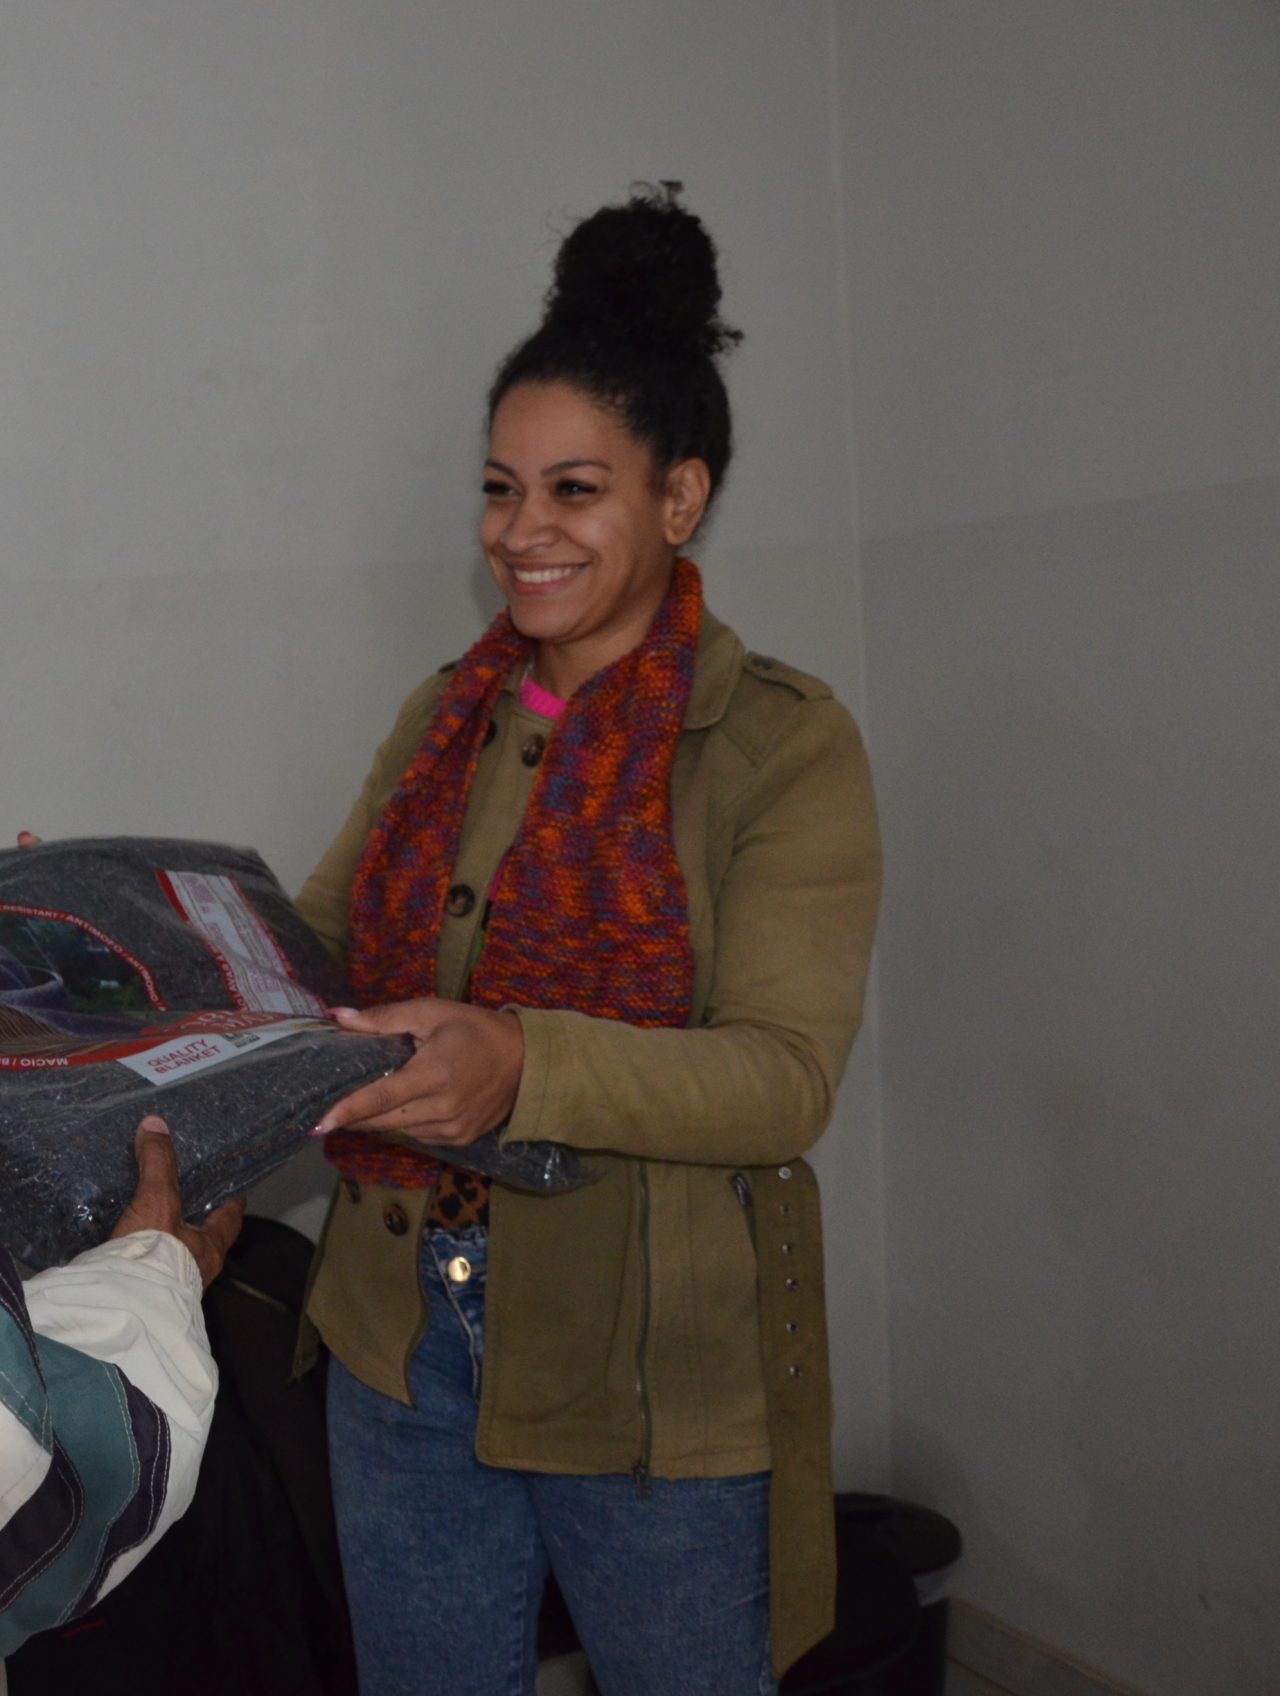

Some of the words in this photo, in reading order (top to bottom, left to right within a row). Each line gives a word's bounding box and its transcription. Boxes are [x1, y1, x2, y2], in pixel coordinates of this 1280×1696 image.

[20, 1057, 68, 1067] MACIO
[147, 1038, 208, 1067] QUALITY
[153, 1044, 222, 1074] BLANKET
